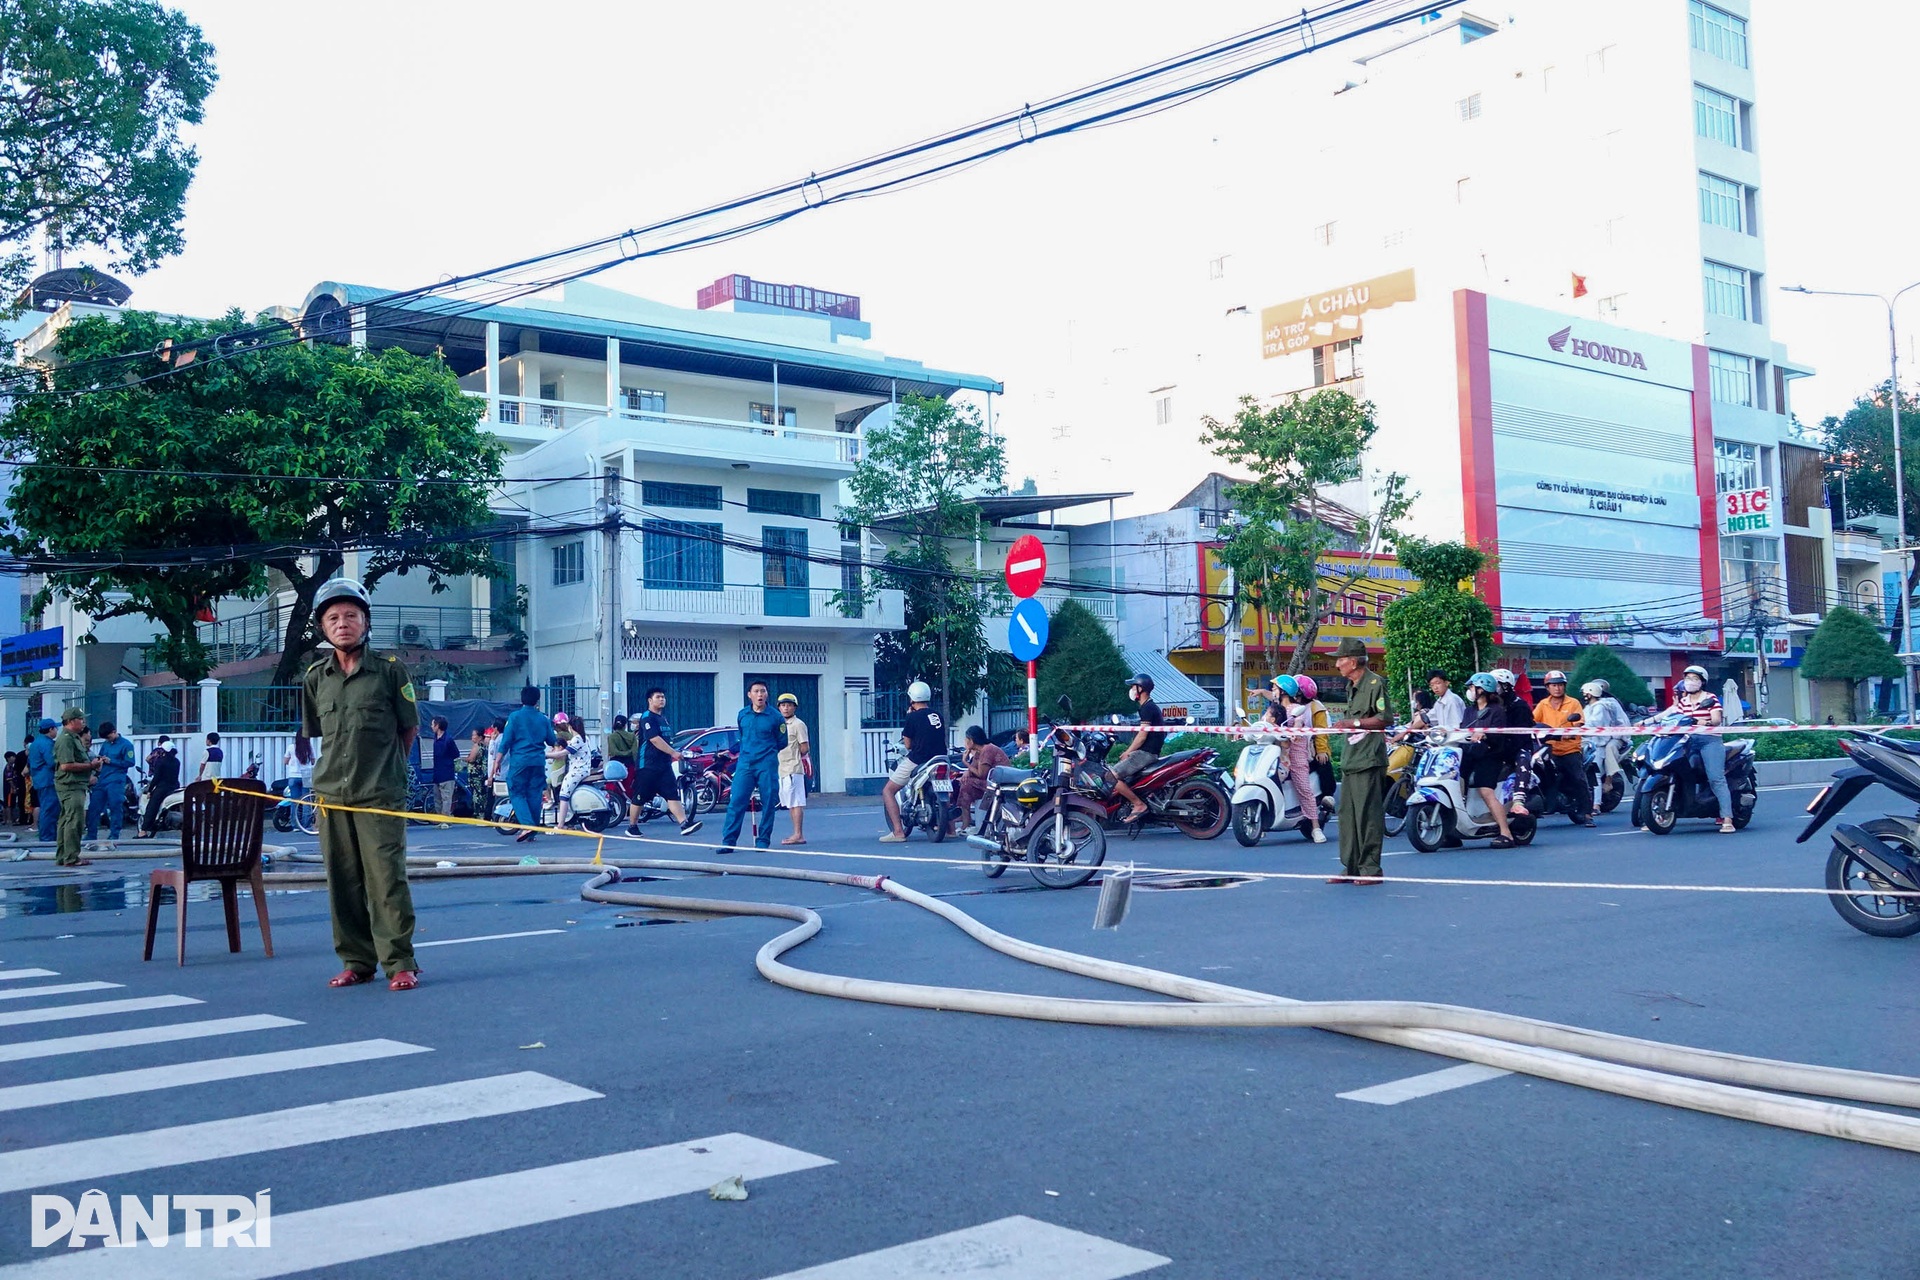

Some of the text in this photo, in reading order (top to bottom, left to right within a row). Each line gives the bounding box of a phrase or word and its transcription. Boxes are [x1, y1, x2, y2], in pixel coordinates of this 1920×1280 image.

[1301, 286, 1370, 319] Á CHÂU
[1571, 338, 1648, 371] HONDA
[1553, 483, 1561, 492] TY
[1589, 497, 1595, 509] Á
[1596, 499, 1617, 512] CHÂU
[1727, 490, 1767, 515] 31C
[1728, 513, 1770, 532] HOTEL
